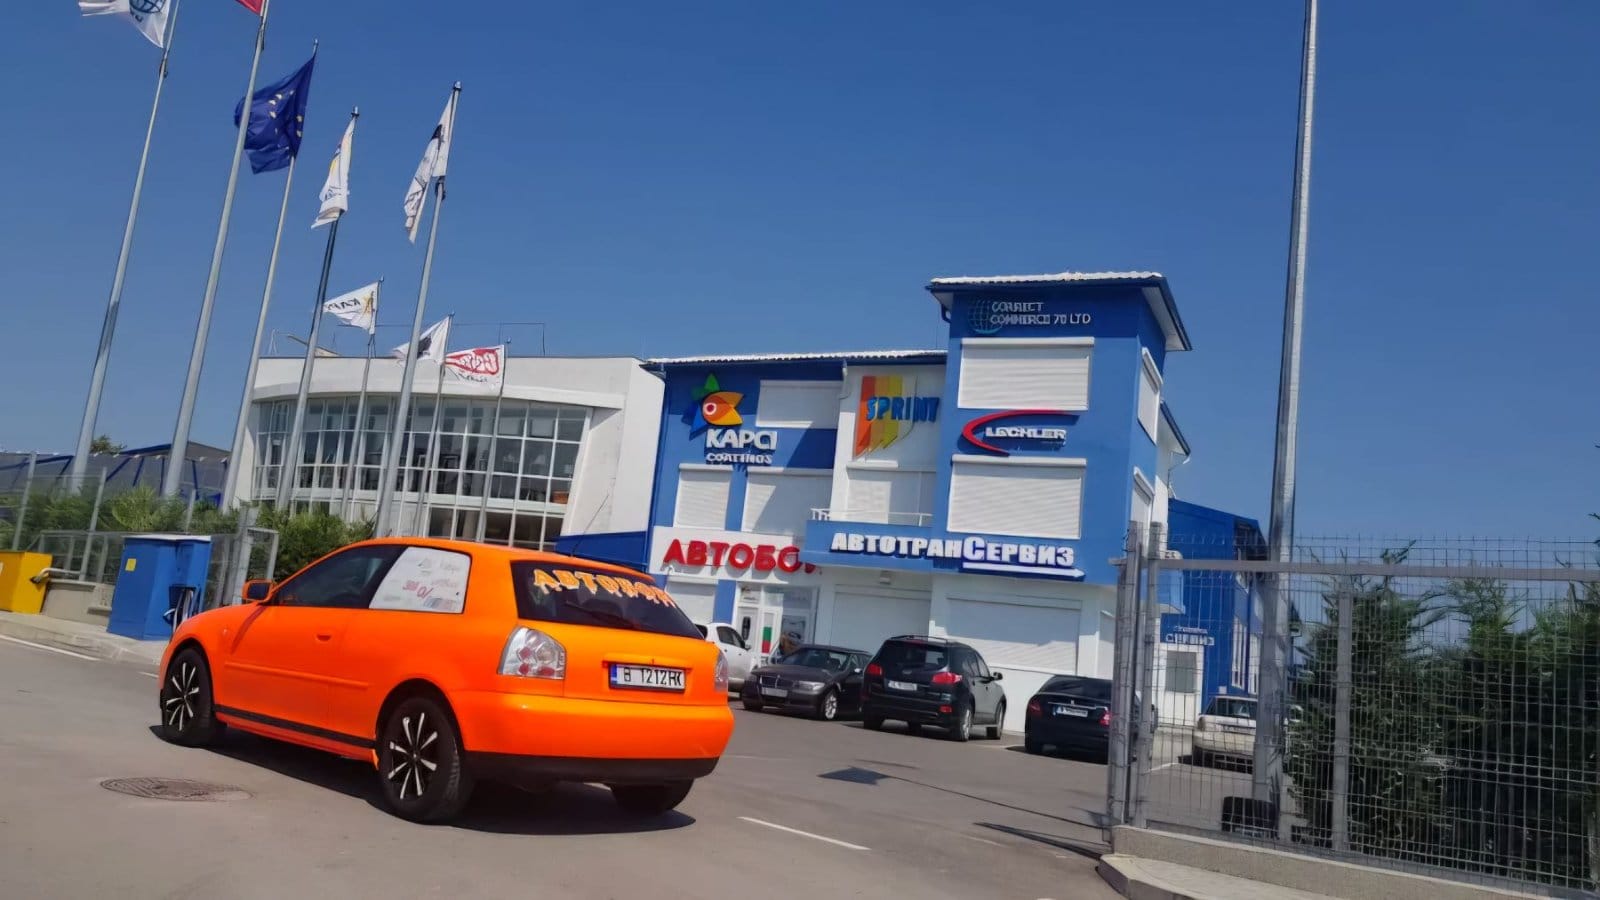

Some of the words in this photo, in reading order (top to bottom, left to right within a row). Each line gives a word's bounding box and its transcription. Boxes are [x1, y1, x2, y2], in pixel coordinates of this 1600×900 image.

[1069, 313, 1091, 324] LTD
[867, 396, 940, 423] SPRINT
[985, 427, 1066, 440] LECHLER
[706, 452, 772, 464] COATINGS
